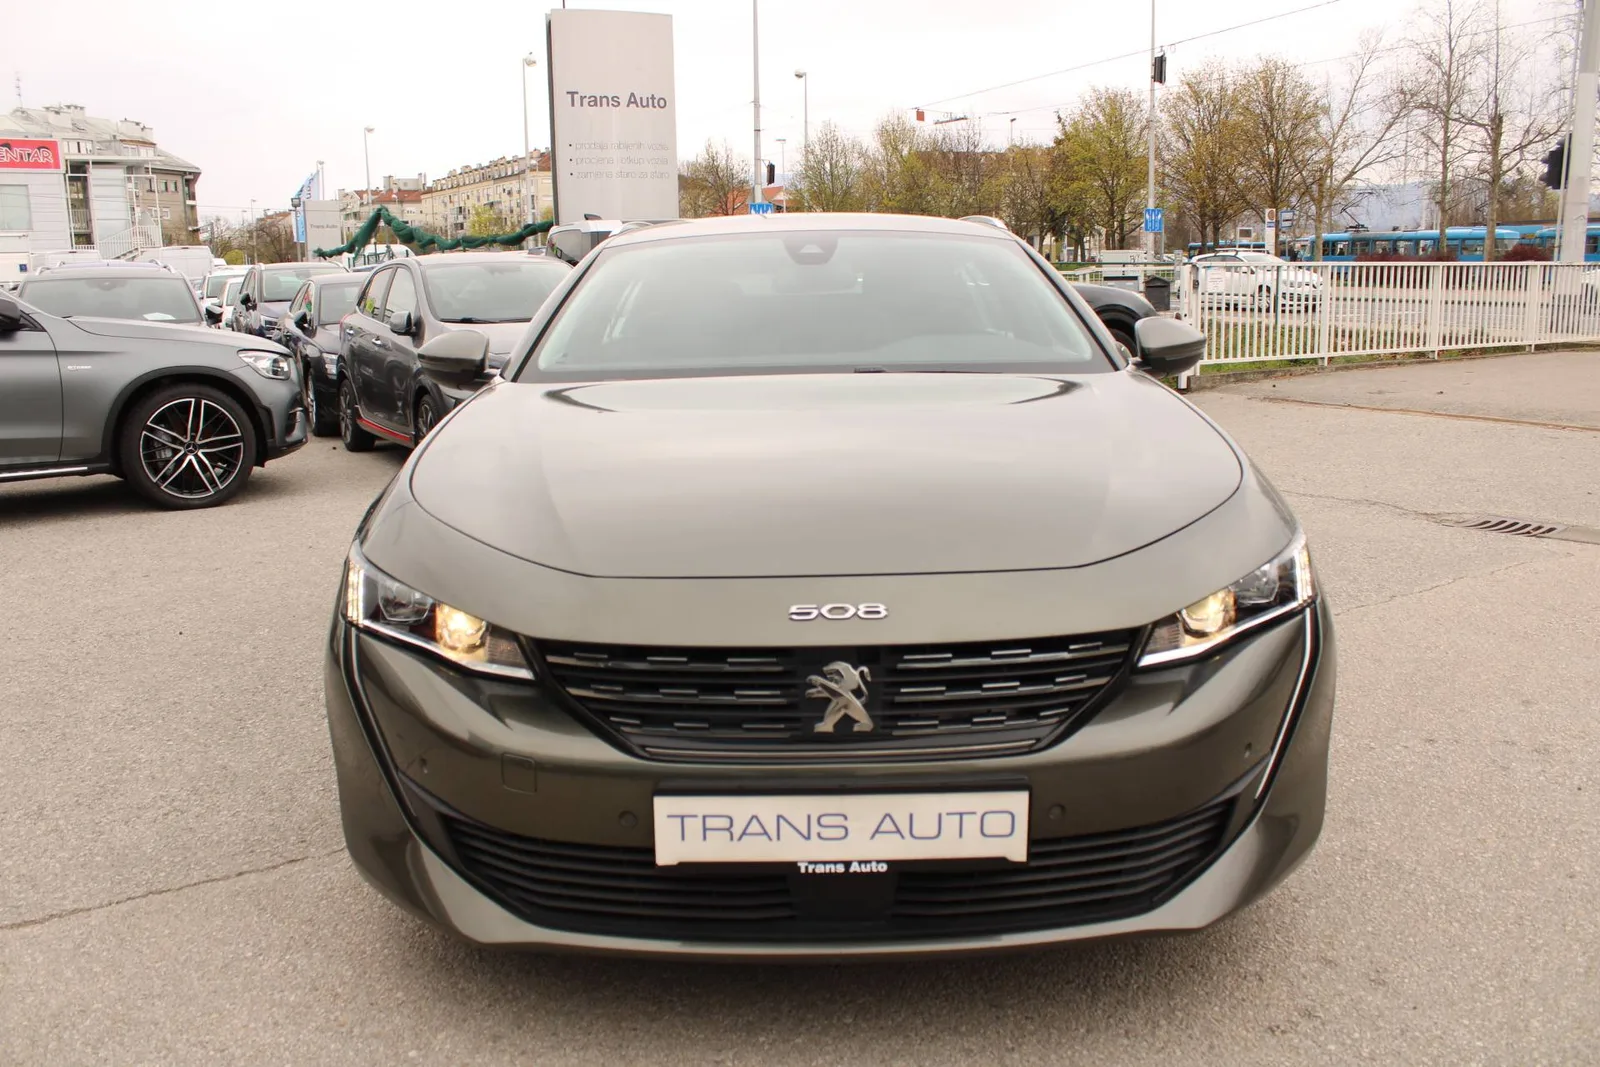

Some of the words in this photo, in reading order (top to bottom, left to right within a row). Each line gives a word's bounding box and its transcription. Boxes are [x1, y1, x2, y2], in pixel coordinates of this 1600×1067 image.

[566, 91, 620, 107] Trans
[626, 92, 667, 108] Auto
[788, 603, 888, 621] 508
[667, 813, 849, 842] TRANS
[870, 810, 1016, 840] AUTO
[797, 861, 846, 874] Trans
[849, 860, 889, 873] Auto
